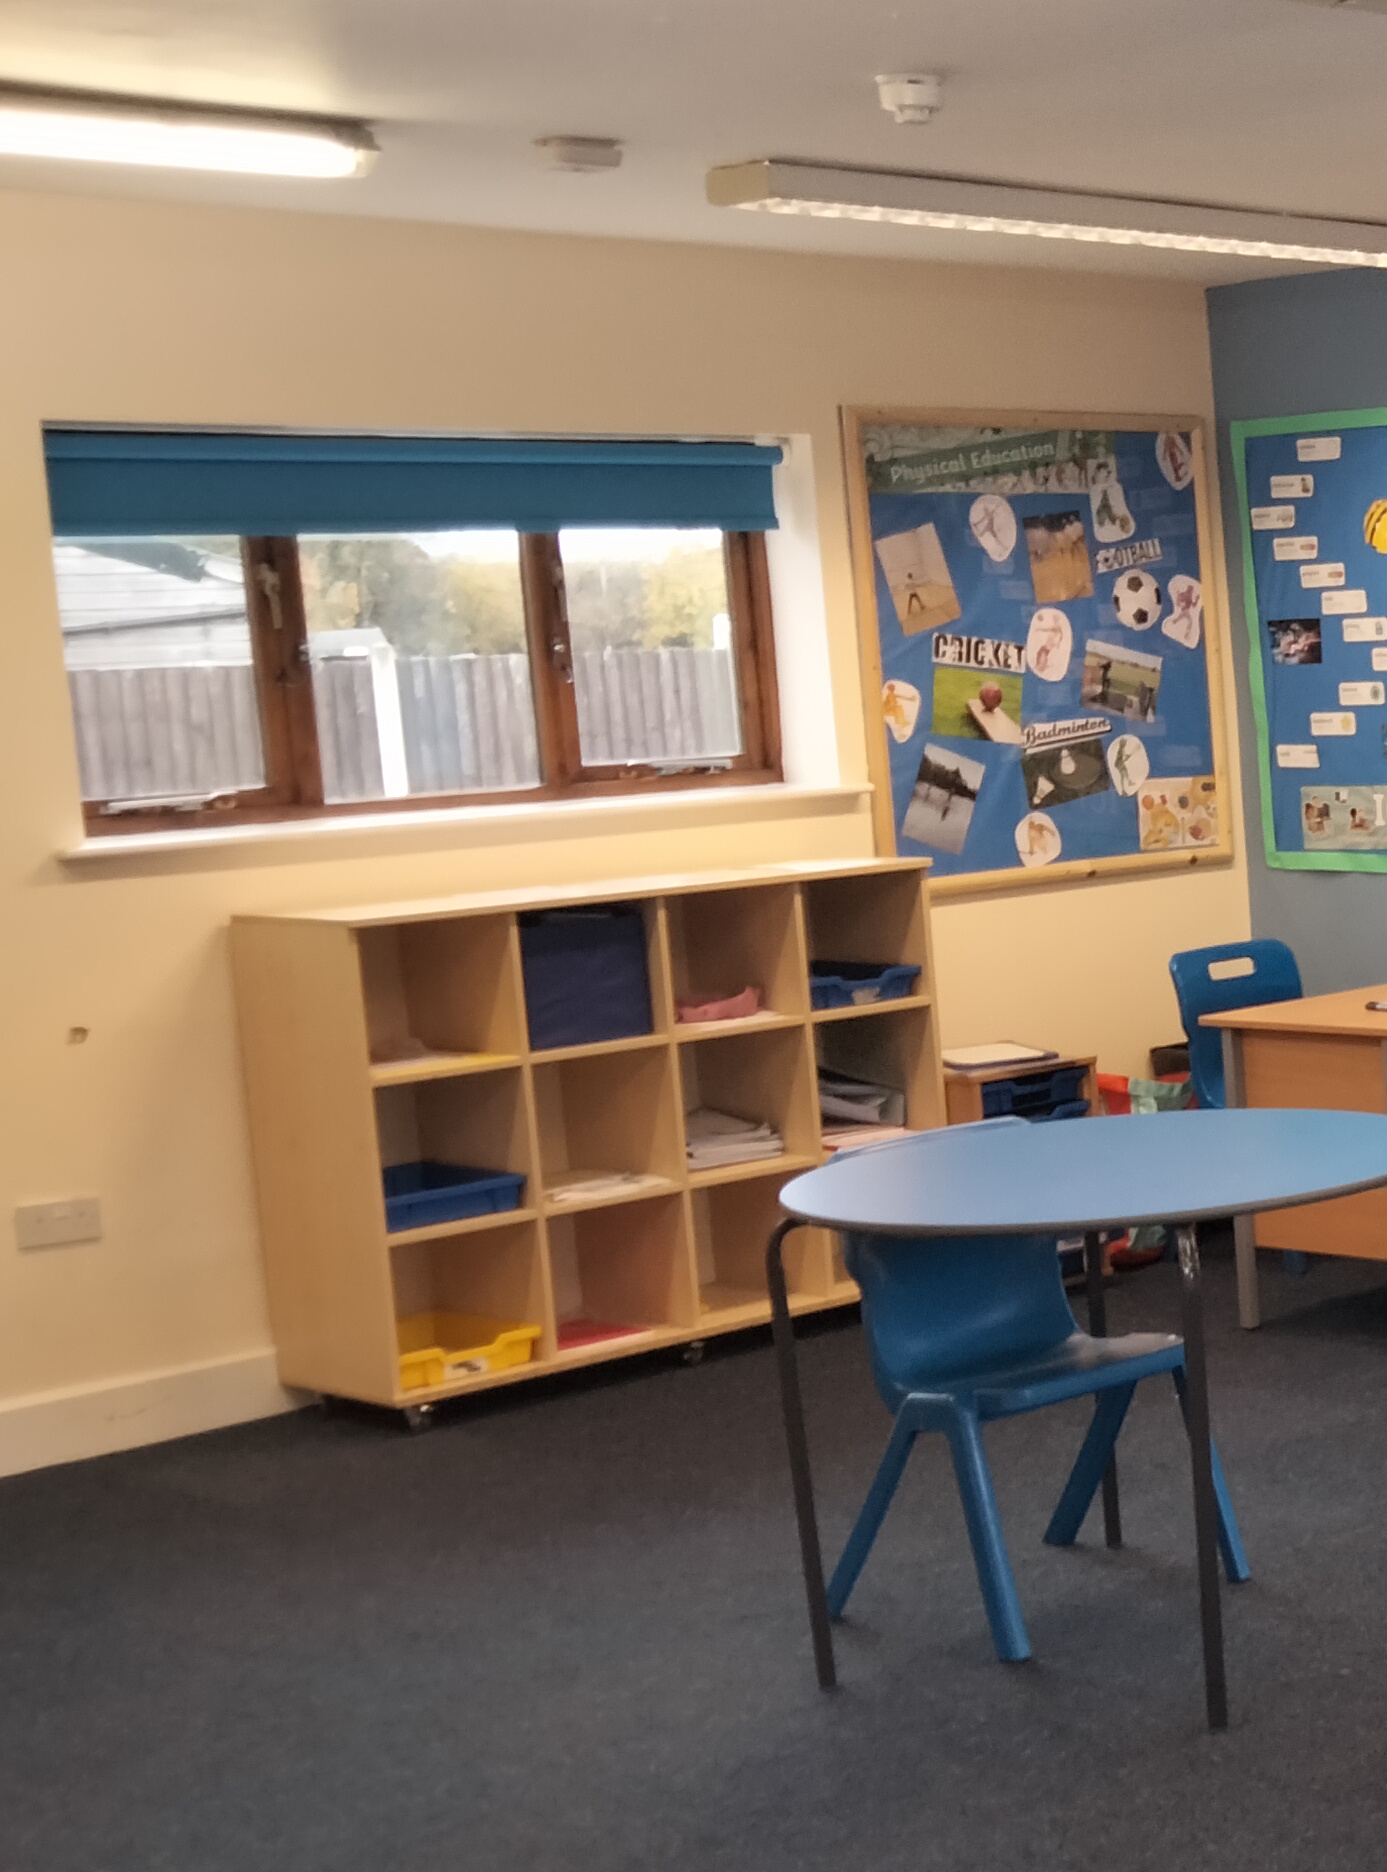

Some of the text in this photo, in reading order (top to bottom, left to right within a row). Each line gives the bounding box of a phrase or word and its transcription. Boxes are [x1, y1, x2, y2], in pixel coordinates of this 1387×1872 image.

[890, 444, 1055, 484] Physical Education
[934, 634, 1026, 669] CRICKET
[1023, 719, 1111, 745] Badminton
